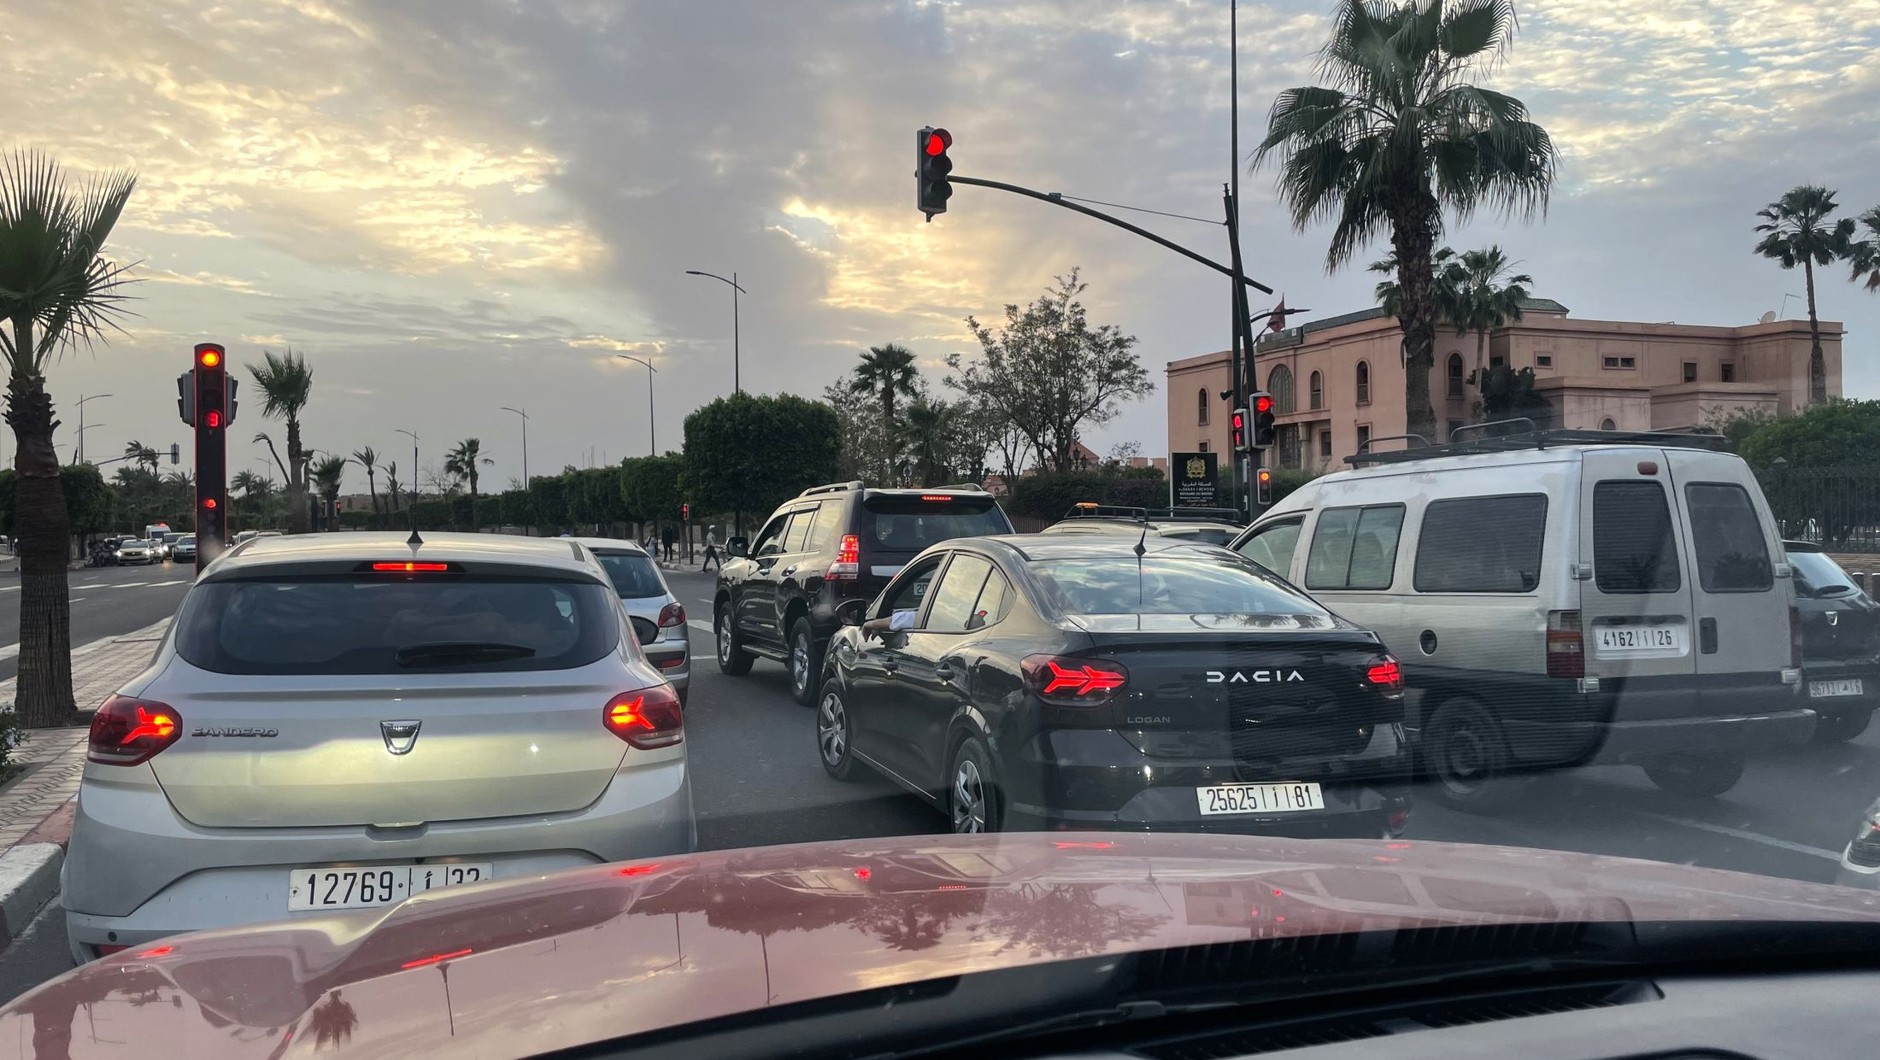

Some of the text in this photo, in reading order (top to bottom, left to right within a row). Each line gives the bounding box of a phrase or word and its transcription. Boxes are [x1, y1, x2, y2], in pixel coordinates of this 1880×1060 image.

[1603, 631, 1634, 647] 4162
[1657, 630, 1672, 645] 26
[1206, 670, 1305, 683] DACIA
[1127, 716, 1171, 724] LOGAN
[192, 728, 279, 738] SANDERO
[1206, 787, 1258, 812] 25625
[1294, 785, 1313, 808] 81
[307, 870, 395, 905] 12769
